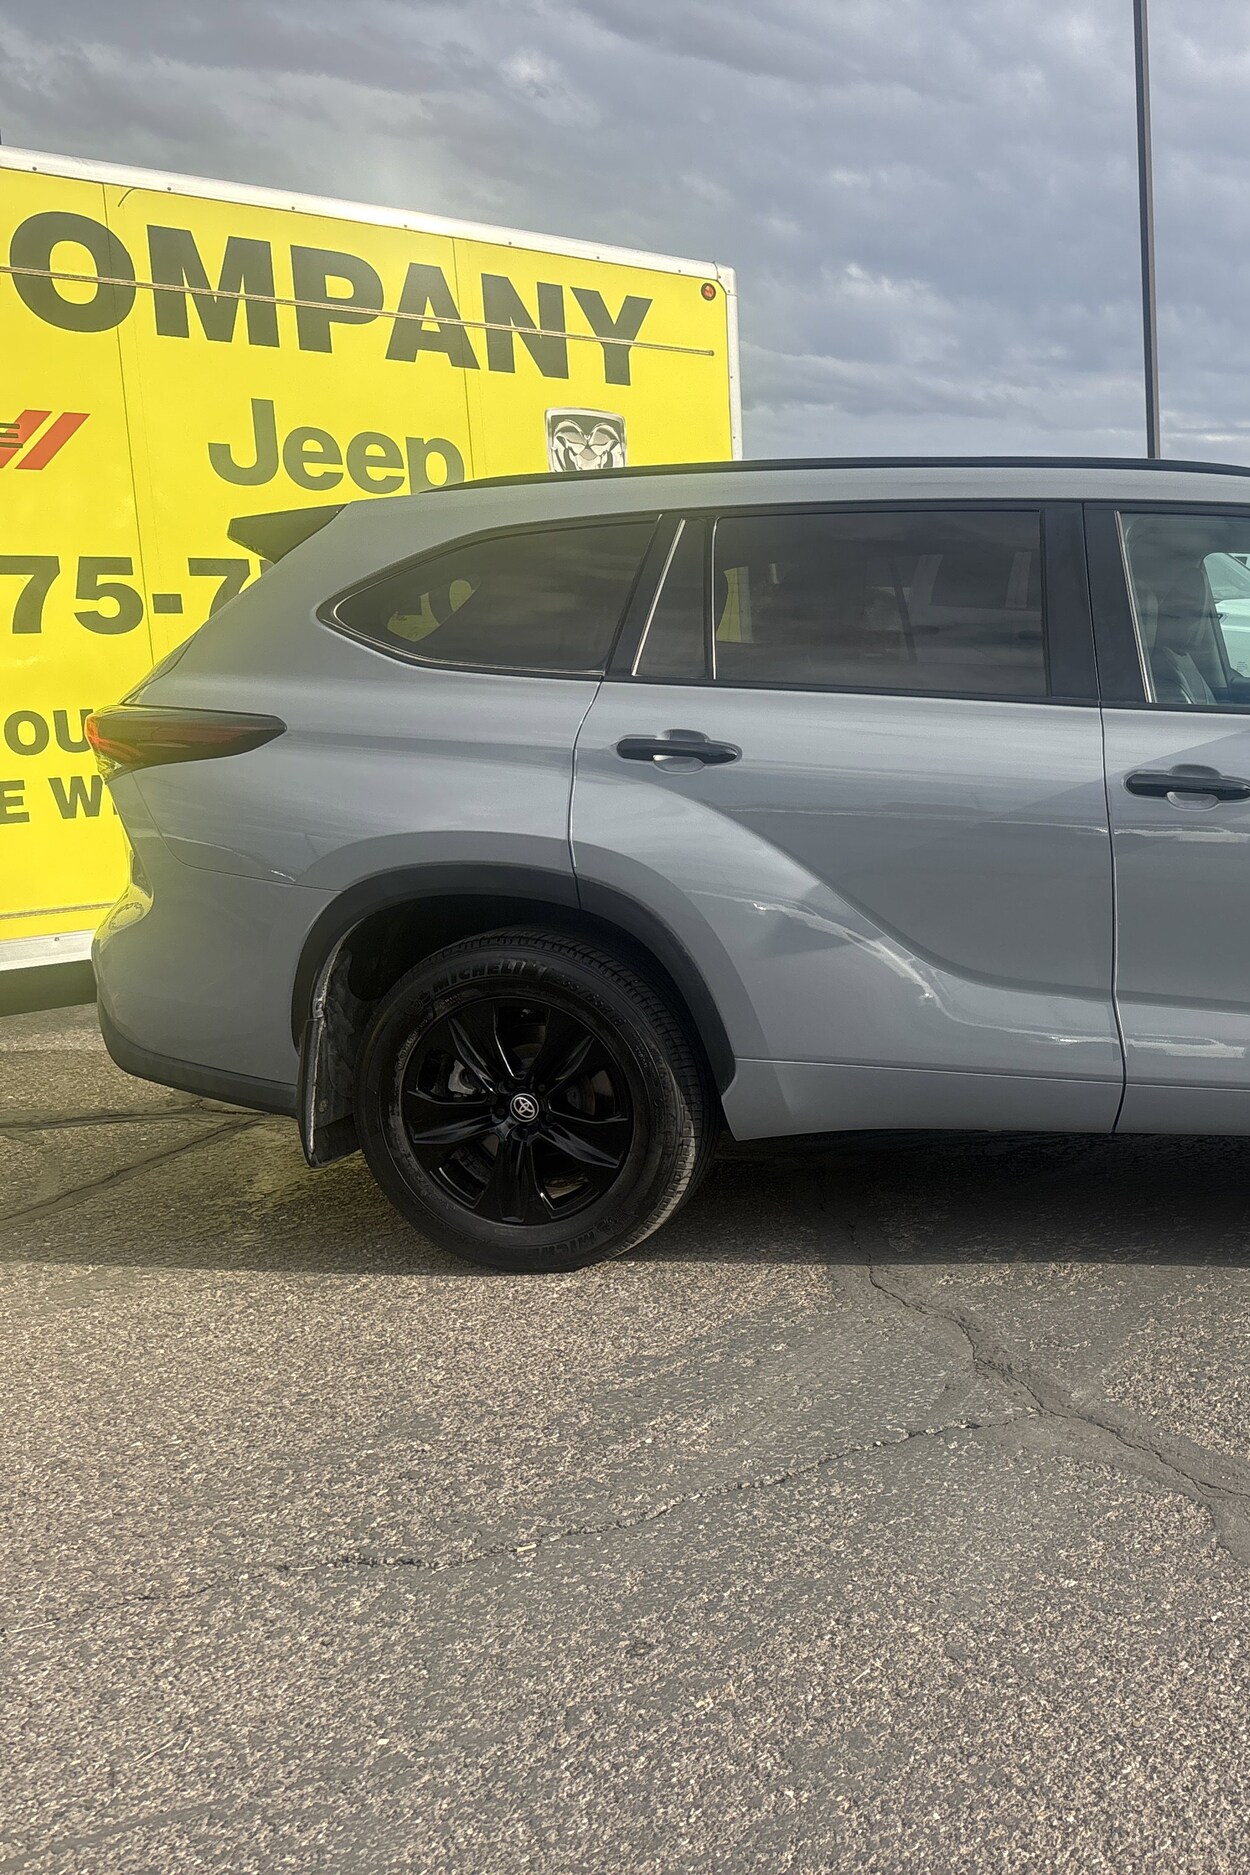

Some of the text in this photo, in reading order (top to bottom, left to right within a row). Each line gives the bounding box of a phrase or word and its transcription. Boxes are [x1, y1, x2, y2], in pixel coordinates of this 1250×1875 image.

[207, 398, 465, 495] Jeep
[0, 555, 273, 635] 75-7
[48, 775, 119, 820] W
